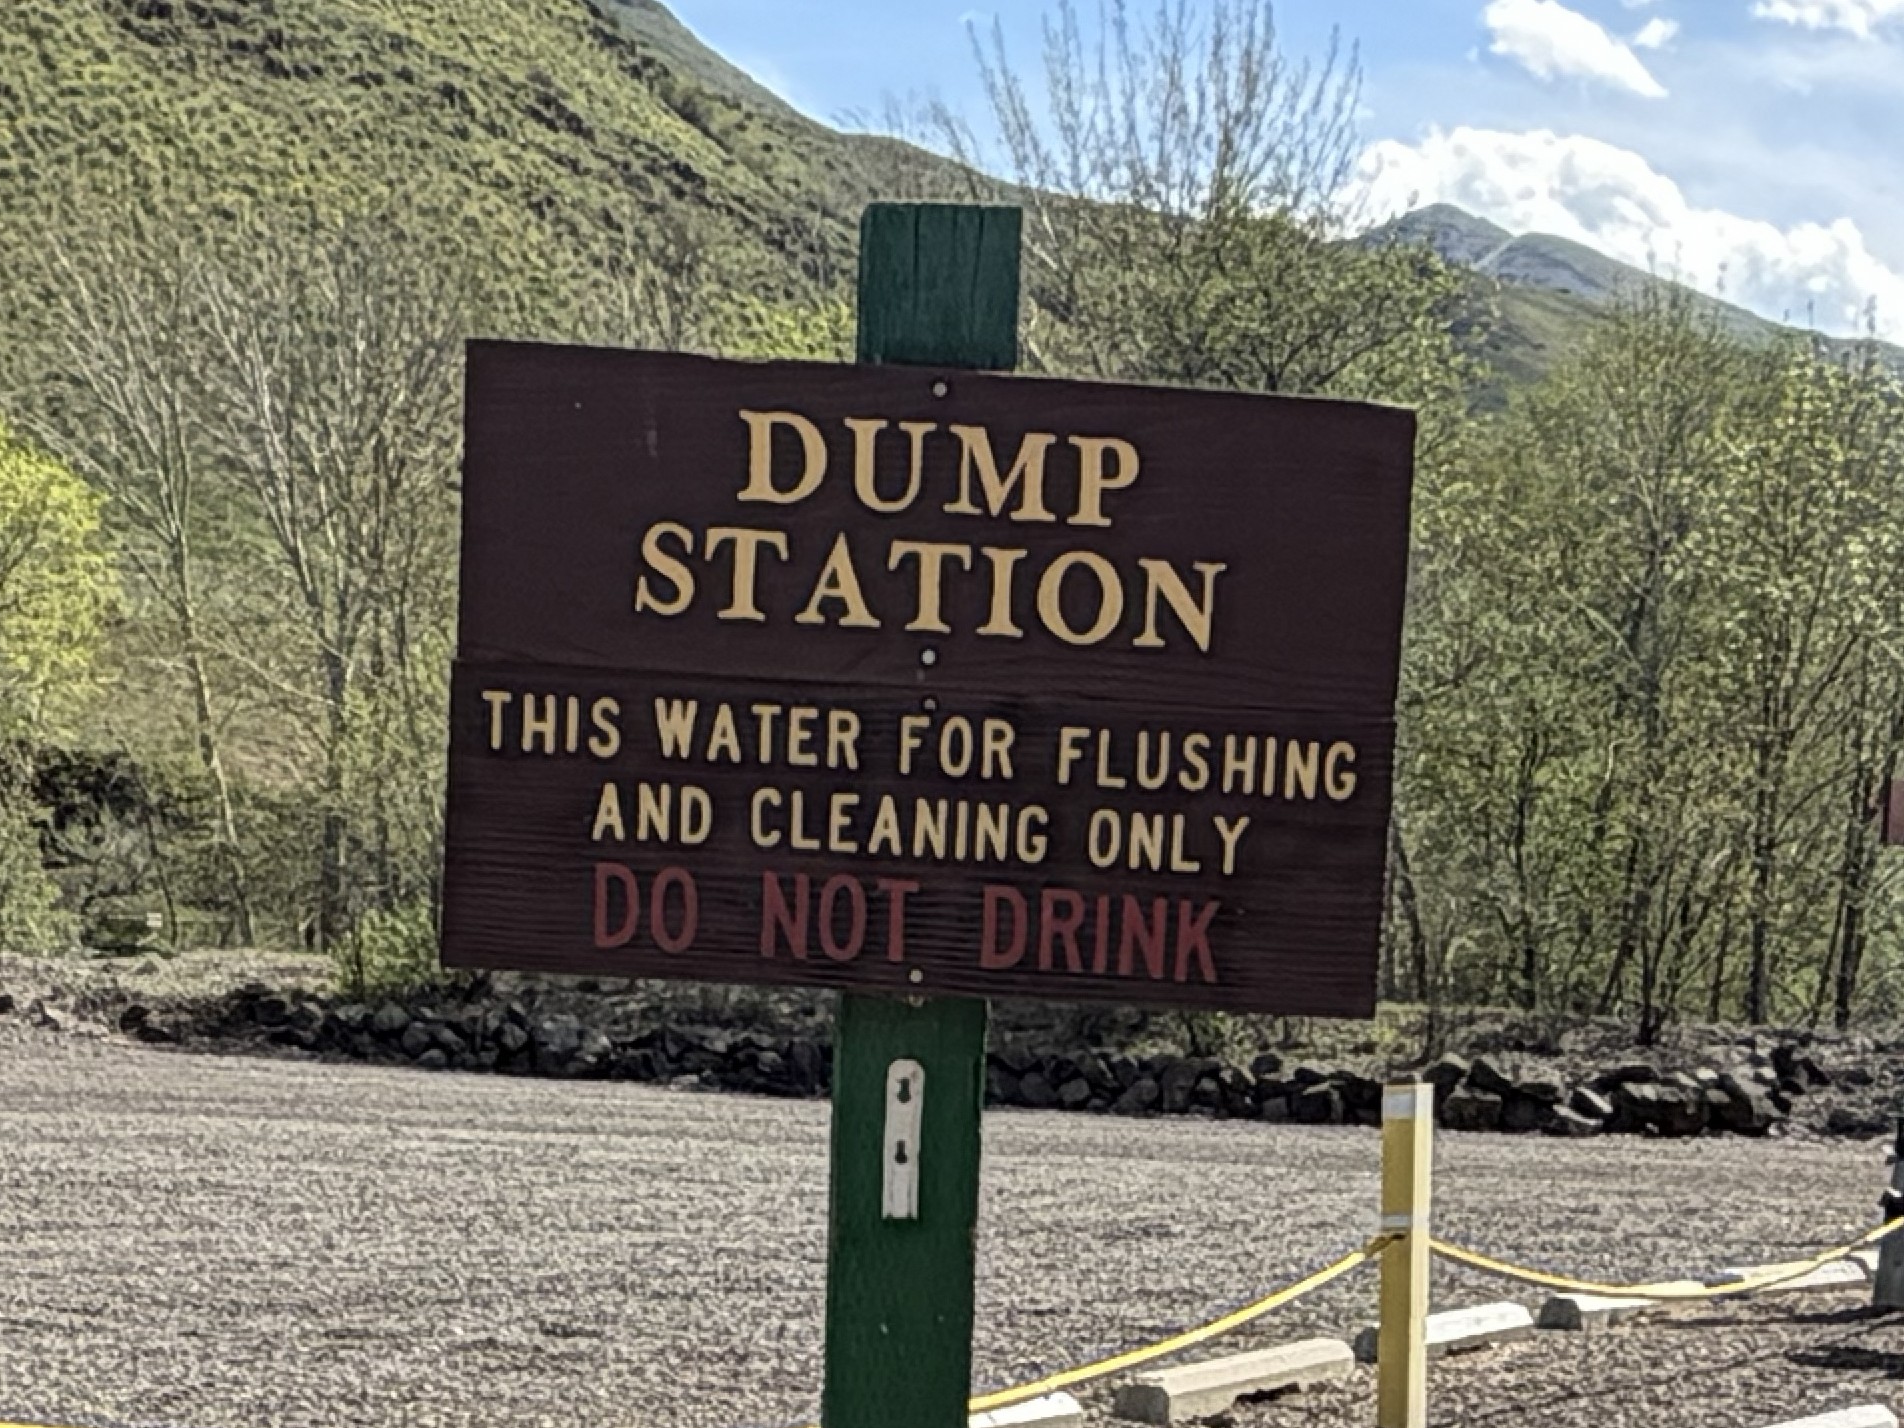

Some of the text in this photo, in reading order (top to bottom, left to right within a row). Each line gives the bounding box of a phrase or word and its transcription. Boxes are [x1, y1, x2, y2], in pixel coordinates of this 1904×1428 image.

[735, 409, 1141, 527] DUMP
[633, 521, 1227, 653] STATION
[482, 689, 1357, 800] THIS WATER FOR FLUSHING
[590, 781, 1250, 875] AND CLEANING ONLY
[594, 862, 1221, 983] DO NOT DRINK
